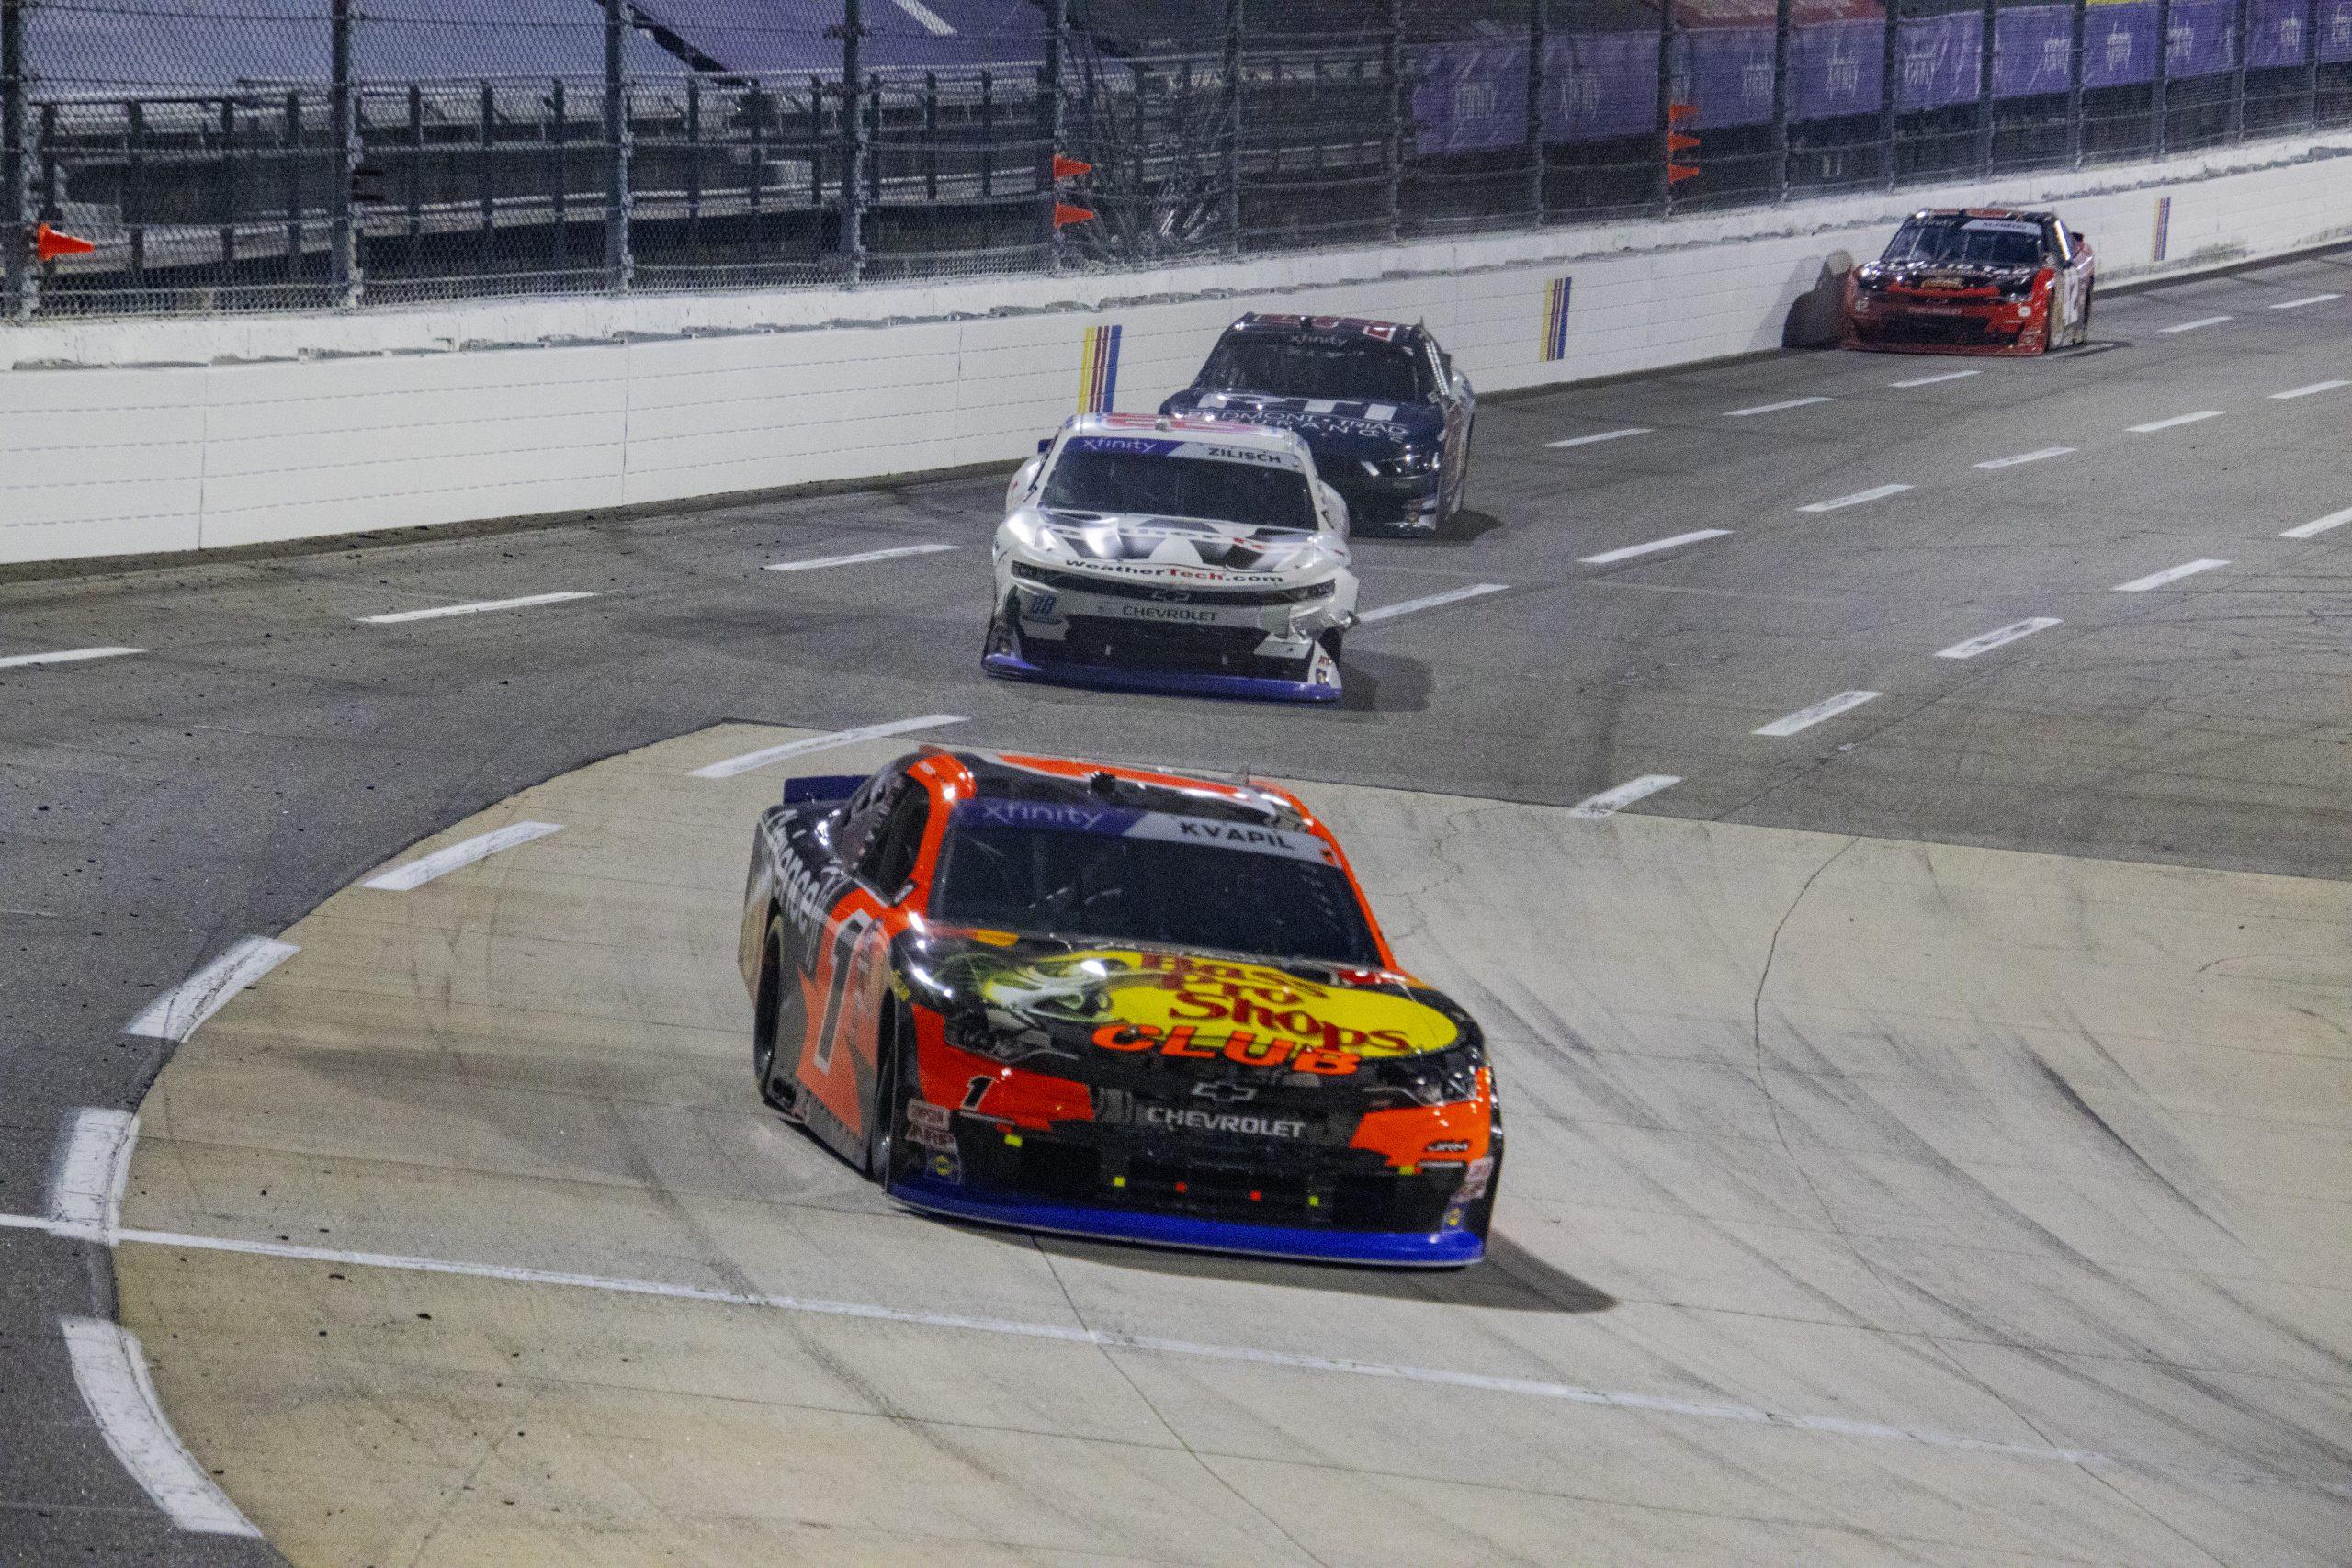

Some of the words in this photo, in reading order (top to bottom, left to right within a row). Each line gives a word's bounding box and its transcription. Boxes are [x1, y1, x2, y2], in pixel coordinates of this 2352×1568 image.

[1082, 437, 1158, 453] xfinity
[1208, 446, 1282, 464] ZILISCH
[1065, 558, 1284, 583] WeatherTech.com
[1122, 605, 1218, 623] CHEVROLET
[983, 804, 1103, 831] xfinity
[1180, 822, 1295, 851] KVAPIL
[1139, 952, 1331, 1001] Bass
[1169, 990, 1412, 1052] Shops
[1091, 1024, 1362, 1076] CLUB
[960, 1074, 996, 1111] 1
[1147, 1106, 1307, 1139] CHEVROLET
